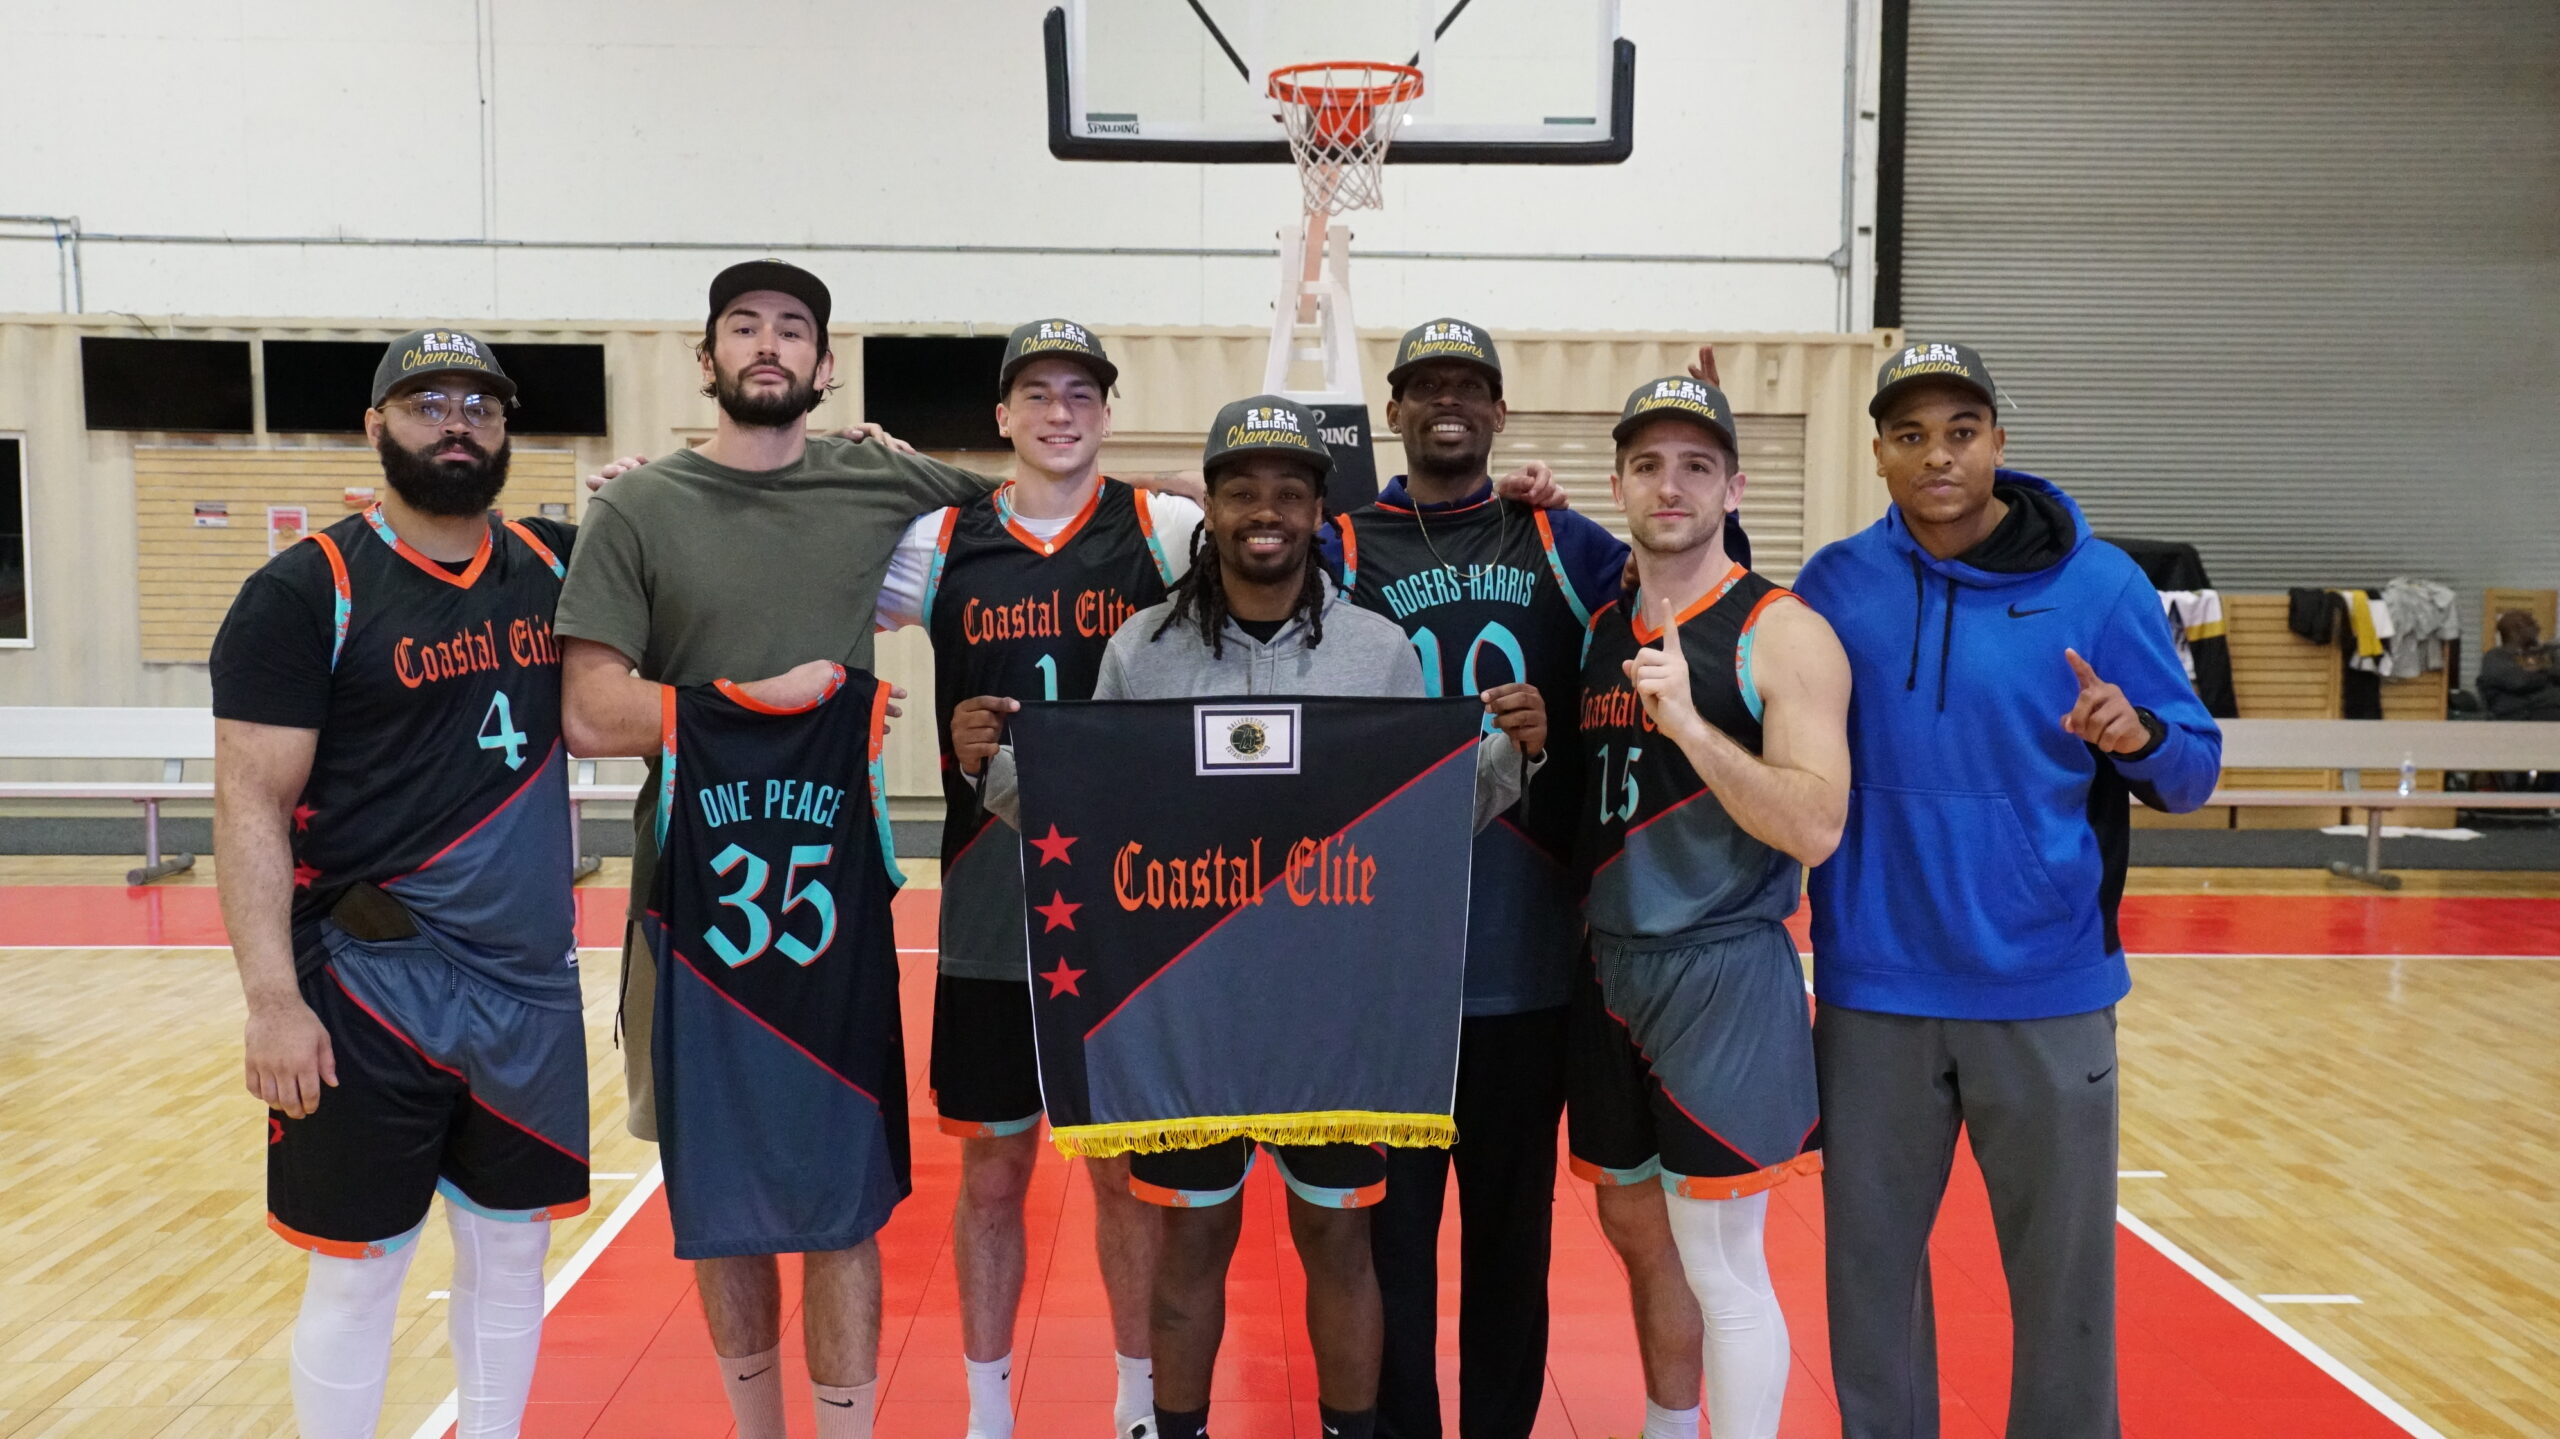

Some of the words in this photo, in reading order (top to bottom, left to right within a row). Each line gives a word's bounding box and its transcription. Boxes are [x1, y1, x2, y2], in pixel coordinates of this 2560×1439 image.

[1087, 122, 1140, 135] SPALDING
[1021, 334, 1094, 355] Champion
[1040, 331, 1088, 347] REGIONAL
[1408, 338, 1484, 361] Champions
[1424, 331, 1475, 345] REGIONAL
[402, 347, 490, 371] Champions
[424, 342, 480, 358] REGIONAL
[1904, 352, 1959, 367] REGIONAL
[1887, 362, 1970, 385] Champions
[1634, 394, 1717, 420] Champions
[1654, 389, 1708, 405] REGIONAL
[1226, 422, 1310, 448] Champions
[1247, 420, 1300, 433] REGIONAL
[1316, 424, 1359, 447] DING
[1381, 564, 1536, 620] ROGERS-HARRIS
[963, 588, 1062, 646] Coastal
[394, 619, 500, 689] Coastal
[508, 614, 561, 668] Elit
[477, 690, 528, 772] 4
[1597, 743, 1642, 825] 15
[699, 780, 753, 828] ONE
[764, 779, 845, 828] PEACE
[1113, 836, 1264, 912] Coastal
[1285, 834, 1377, 907] Elite
[702, 842, 838, 969] 35
